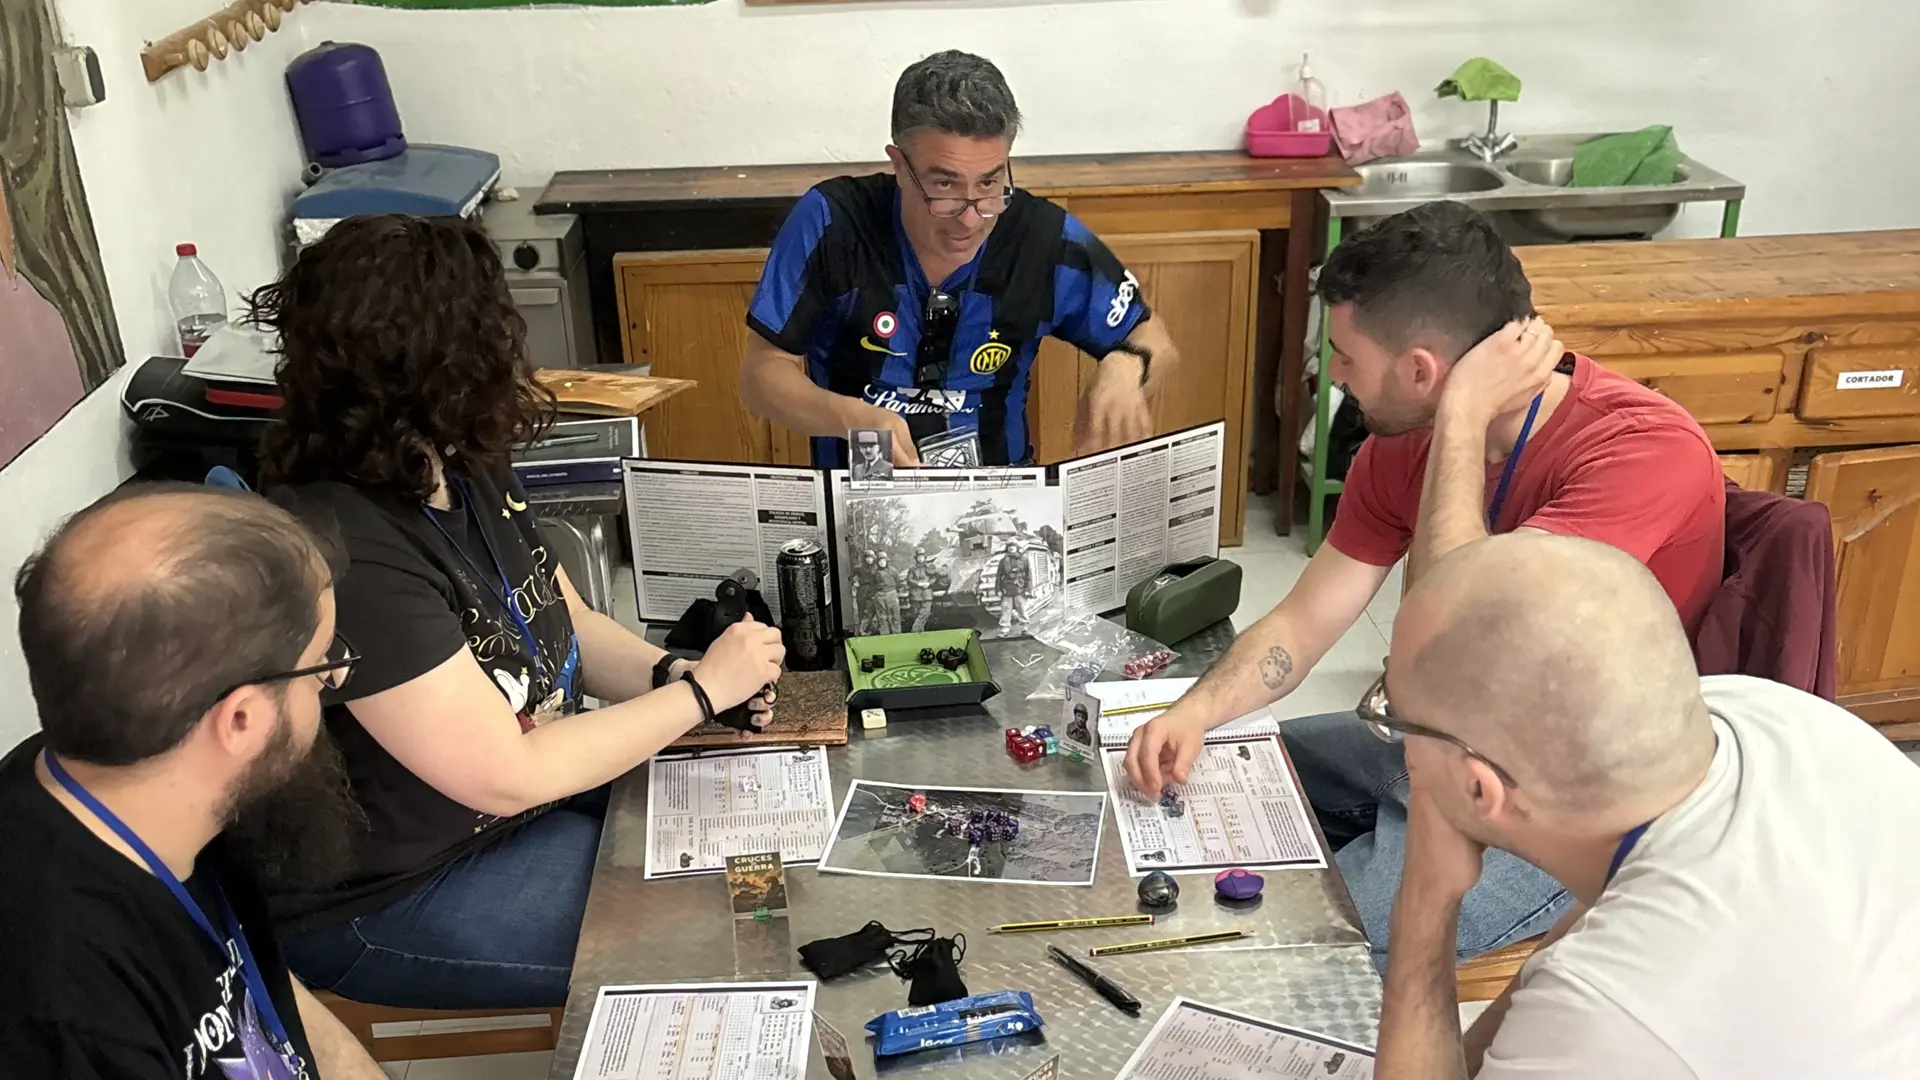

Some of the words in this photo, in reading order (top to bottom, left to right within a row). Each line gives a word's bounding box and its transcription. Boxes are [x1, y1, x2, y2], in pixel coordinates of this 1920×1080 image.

[1107, 269, 1140, 327] ebay
[1845, 375, 1894, 384] CORTADOR
[734, 854, 773, 864] CRUCES
[734, 863, 774, 873] GUERRA
